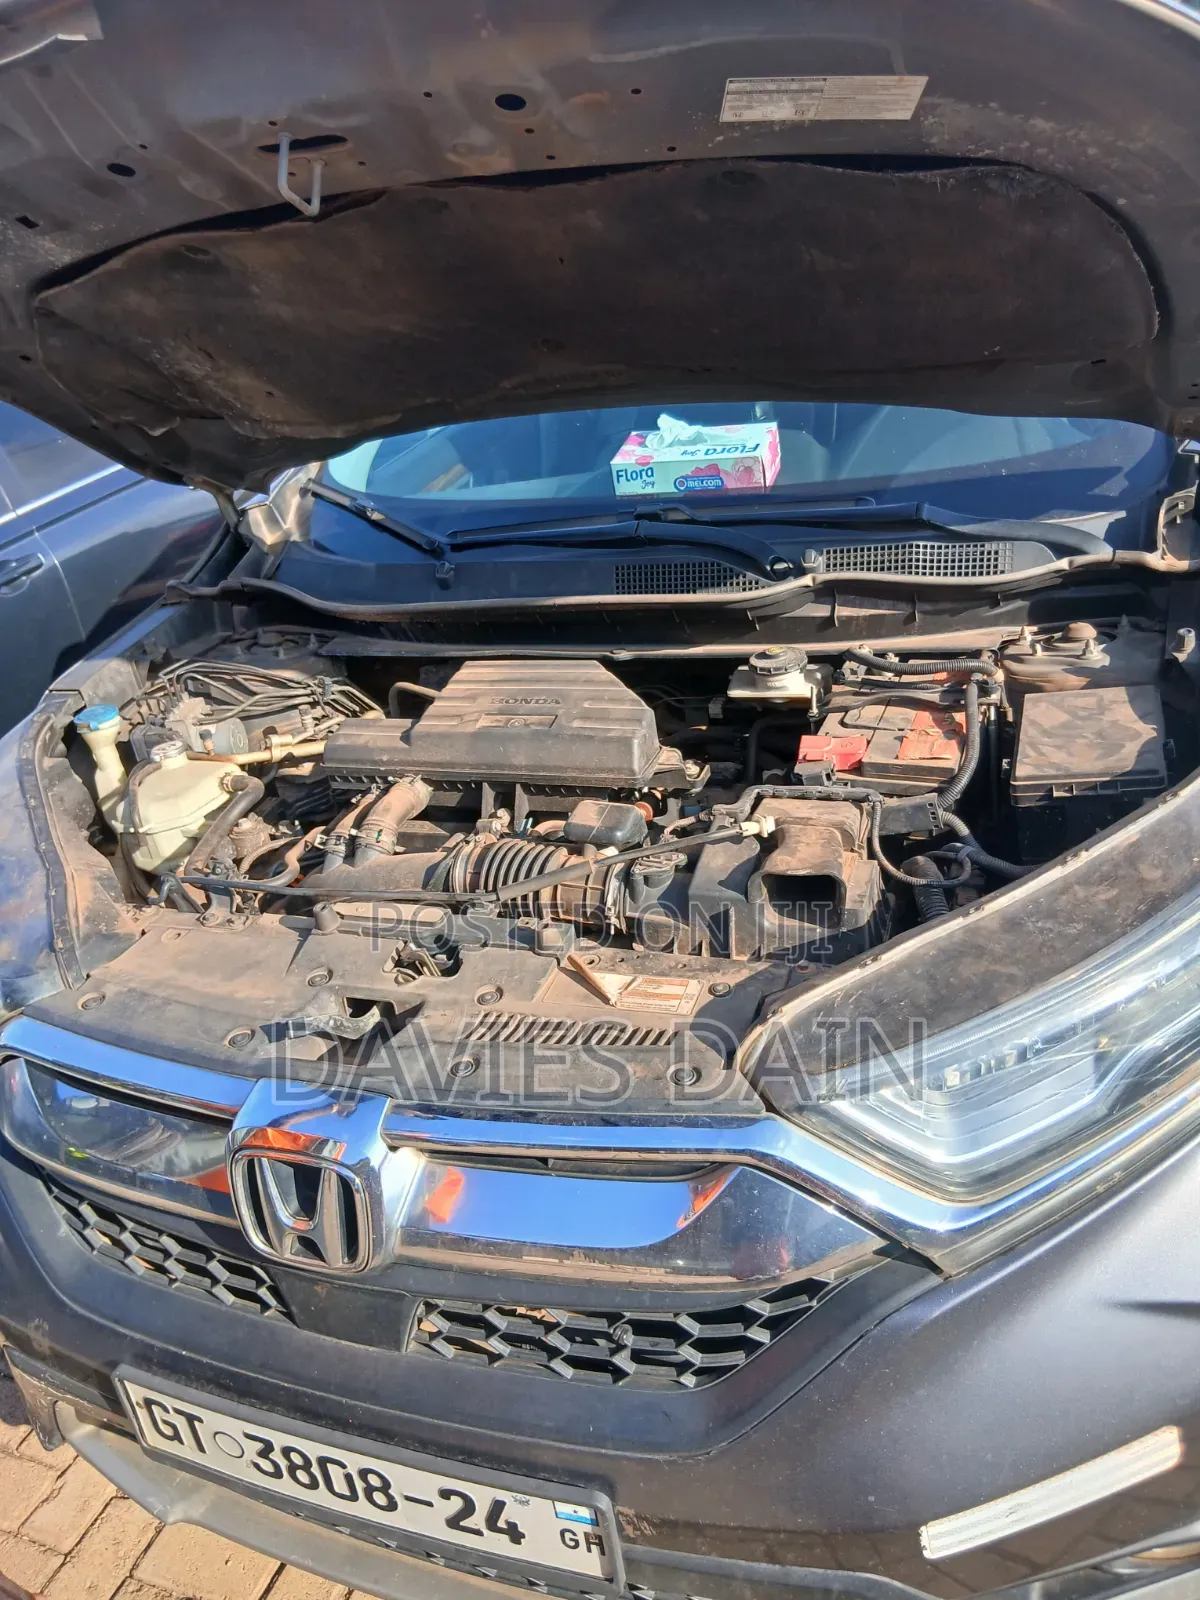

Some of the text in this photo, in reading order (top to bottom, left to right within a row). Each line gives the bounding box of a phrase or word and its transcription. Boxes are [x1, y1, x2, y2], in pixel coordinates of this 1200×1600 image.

[616, 467, 654, 484] Flora
[641, 479, 655, 490] Joy
[142, 1396, 527, 1546] GT 3808-24
[559, 1527, 606, 1557] GH
